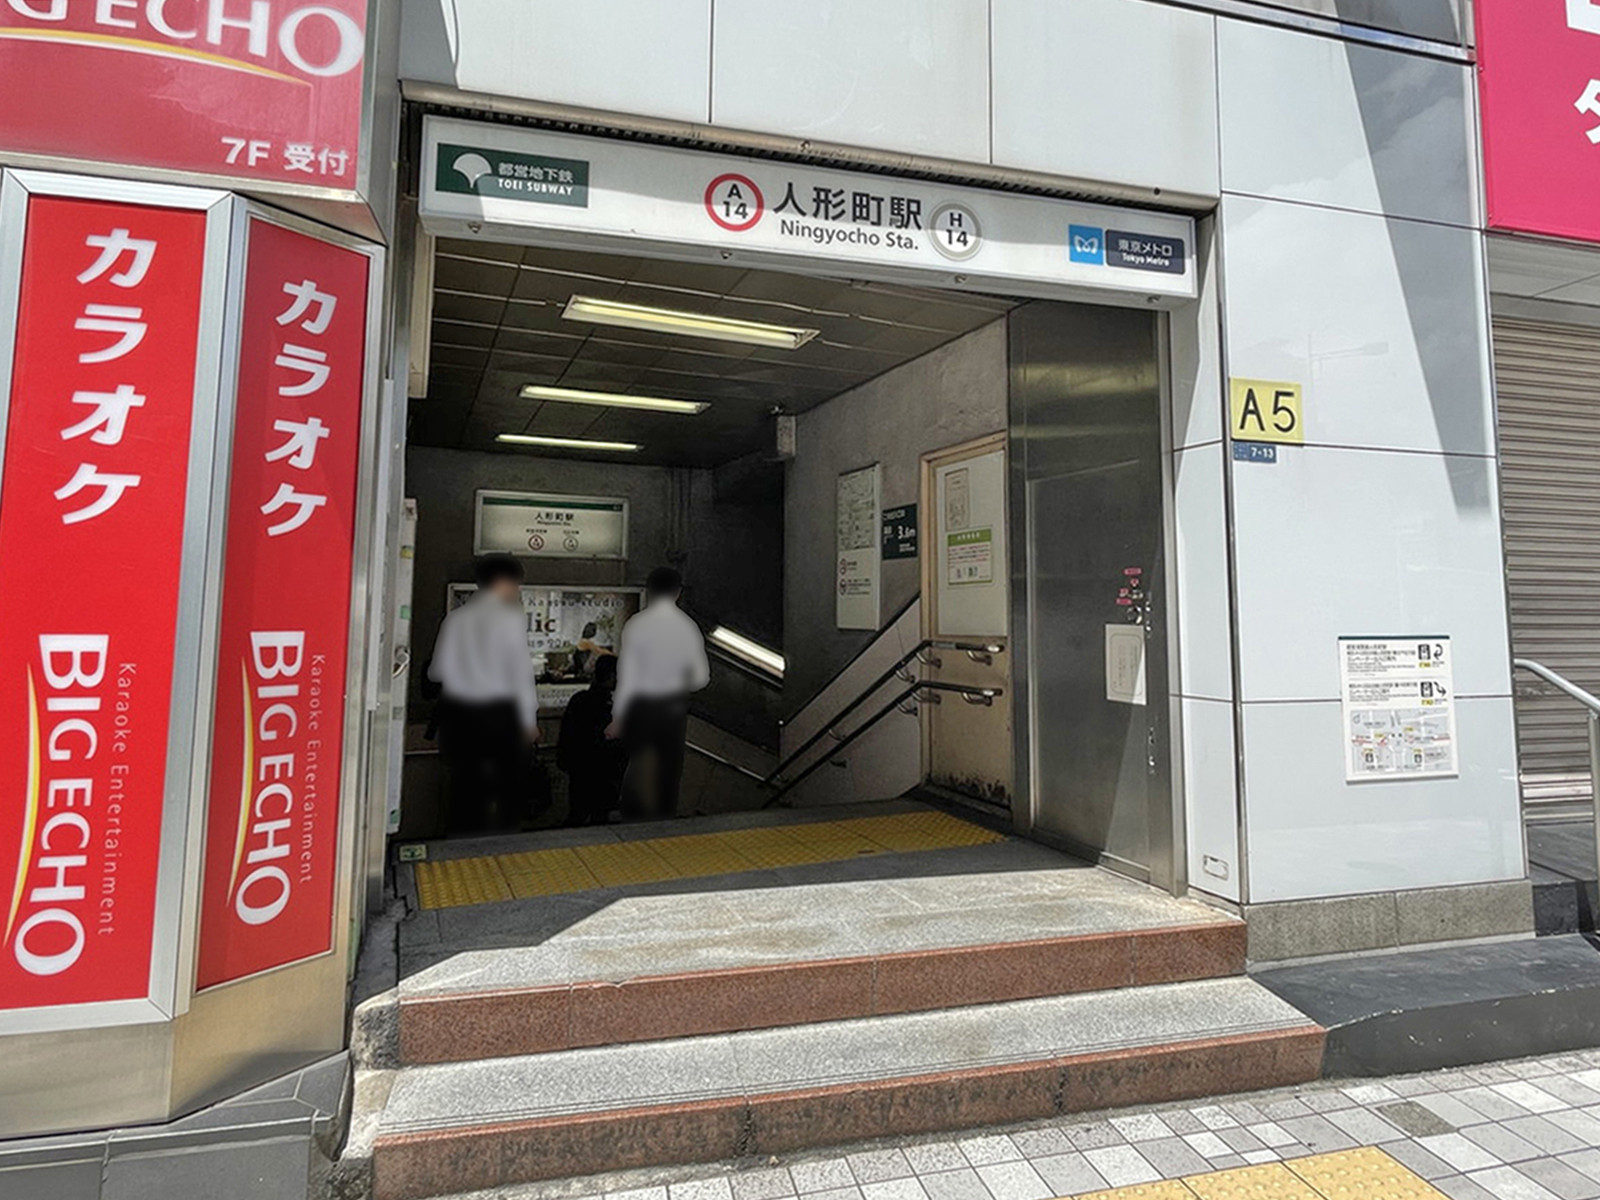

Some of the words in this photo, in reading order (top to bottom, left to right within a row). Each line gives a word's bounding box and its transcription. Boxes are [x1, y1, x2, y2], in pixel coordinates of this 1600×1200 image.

[221, 136, 271, 166] 7F
[283, 142, 349, 177] 受付
[497, 178, 522, 190] TOEI
[527, 181, 573, 196] SUBWAY
[722, 201, 749, 219] 14
[727, 183, 743, 200] A
[773, 182, 923, 231] 人形町駅
[780, 219, 880, 246] Ningyocho
[885, 231, 919, 250] Sta.
[946, 230, 969, 247] 14
[950, 212, 962, 228] H
[1118, 238, 1172, 256] 東京メトロ
[1122, 252, 1145, 265] Tokyo
[1146, 257, 1170, 266] Metro
[53, 228, 158, 525] カラオケ
[260, 279, 338, 537] カラオケ
[1239, 387, 1296, 433] A5
[39, 634, 109, 762] BIG
[112, 663, 137, 753] Karaoke
[250, 631, 305, 742] BIG
[308, 655, 326, 731] Karaoke
[300, 740, 322, 883] Entertainment
[97, 764, 130, 936] Entertainment
[235, 753, 294, 926] ECHO
[14, 778, 93, 976] ECHO
